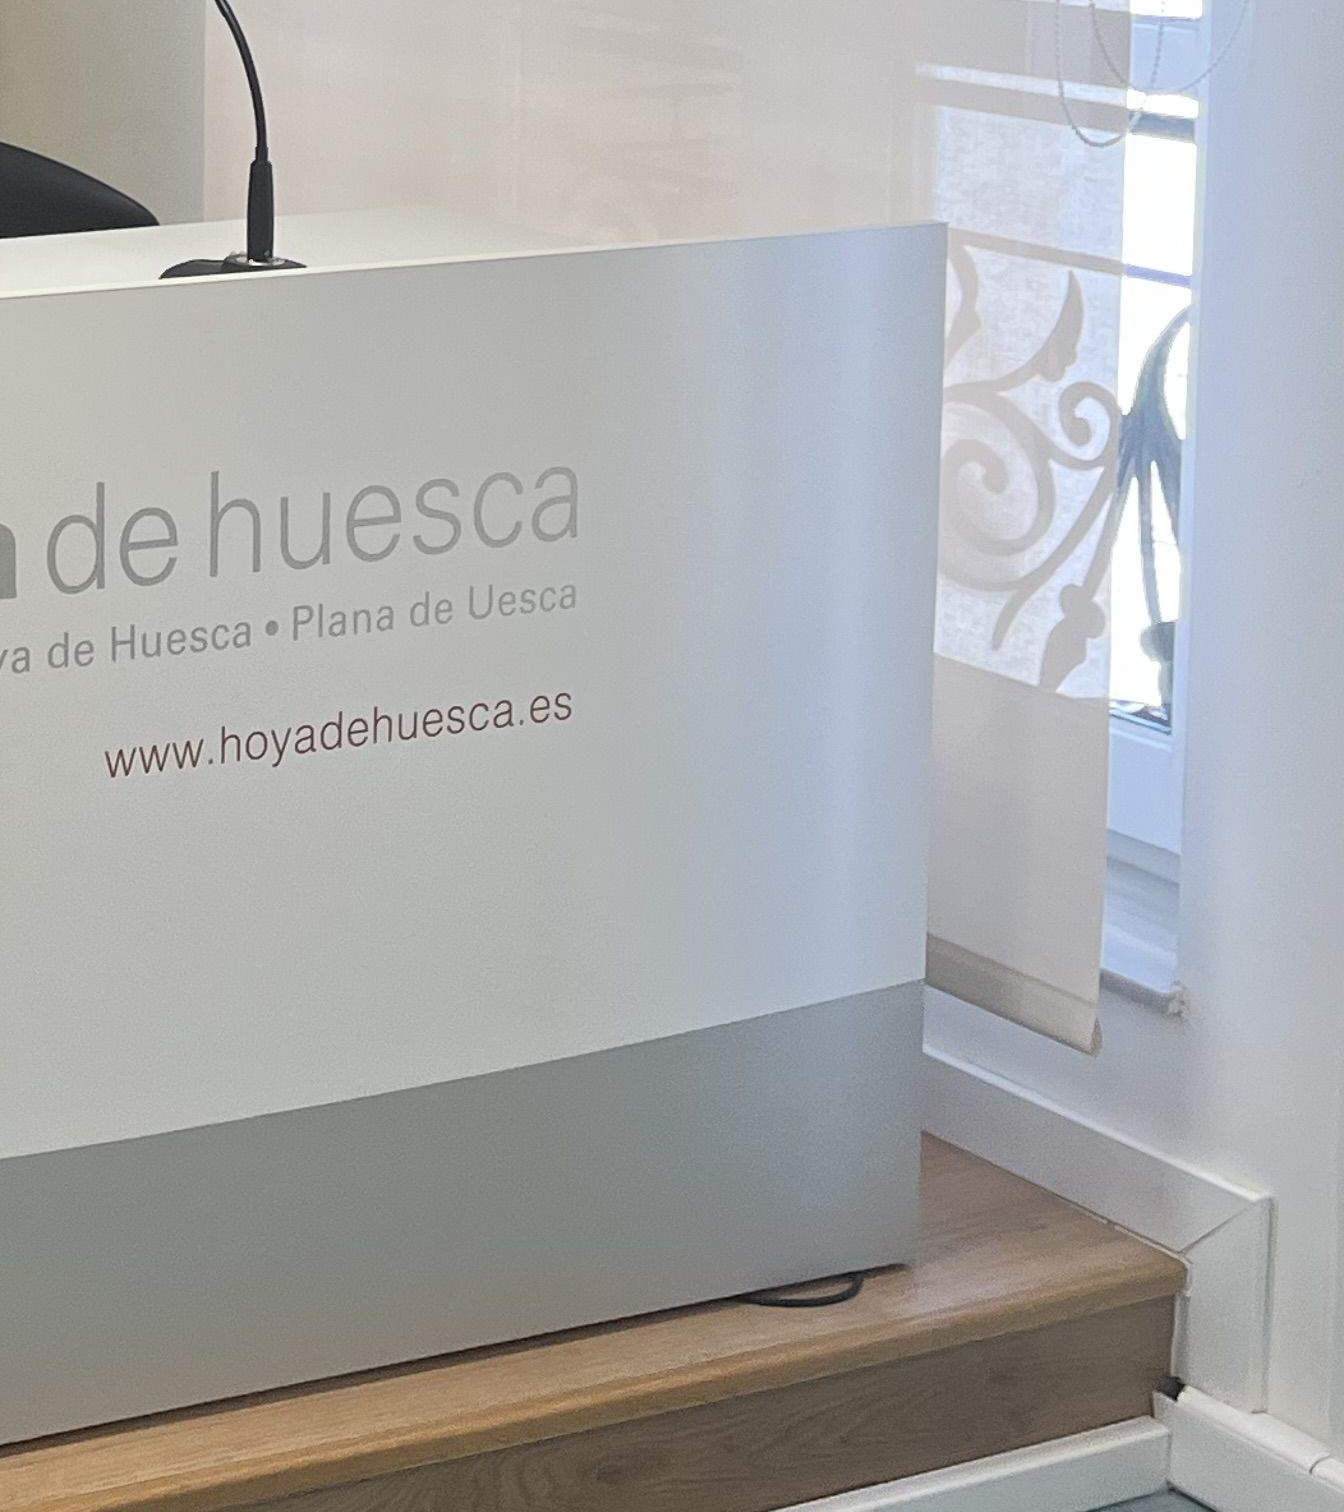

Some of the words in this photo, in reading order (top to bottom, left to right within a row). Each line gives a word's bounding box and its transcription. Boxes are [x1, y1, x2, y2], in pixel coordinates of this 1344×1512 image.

[46, 482, 180, 596] de
[208, 462, 580, 579] huesca
[46, 632, 96, 670] de
[109, 617, 255, 664] Huesca
[291, 603, 398, 643] Plana
[409, 590, 455, 628] de
[467, 579, 579, 620] Uesca
[103, 691, 574, 780] www.hoyadehuesca.es
